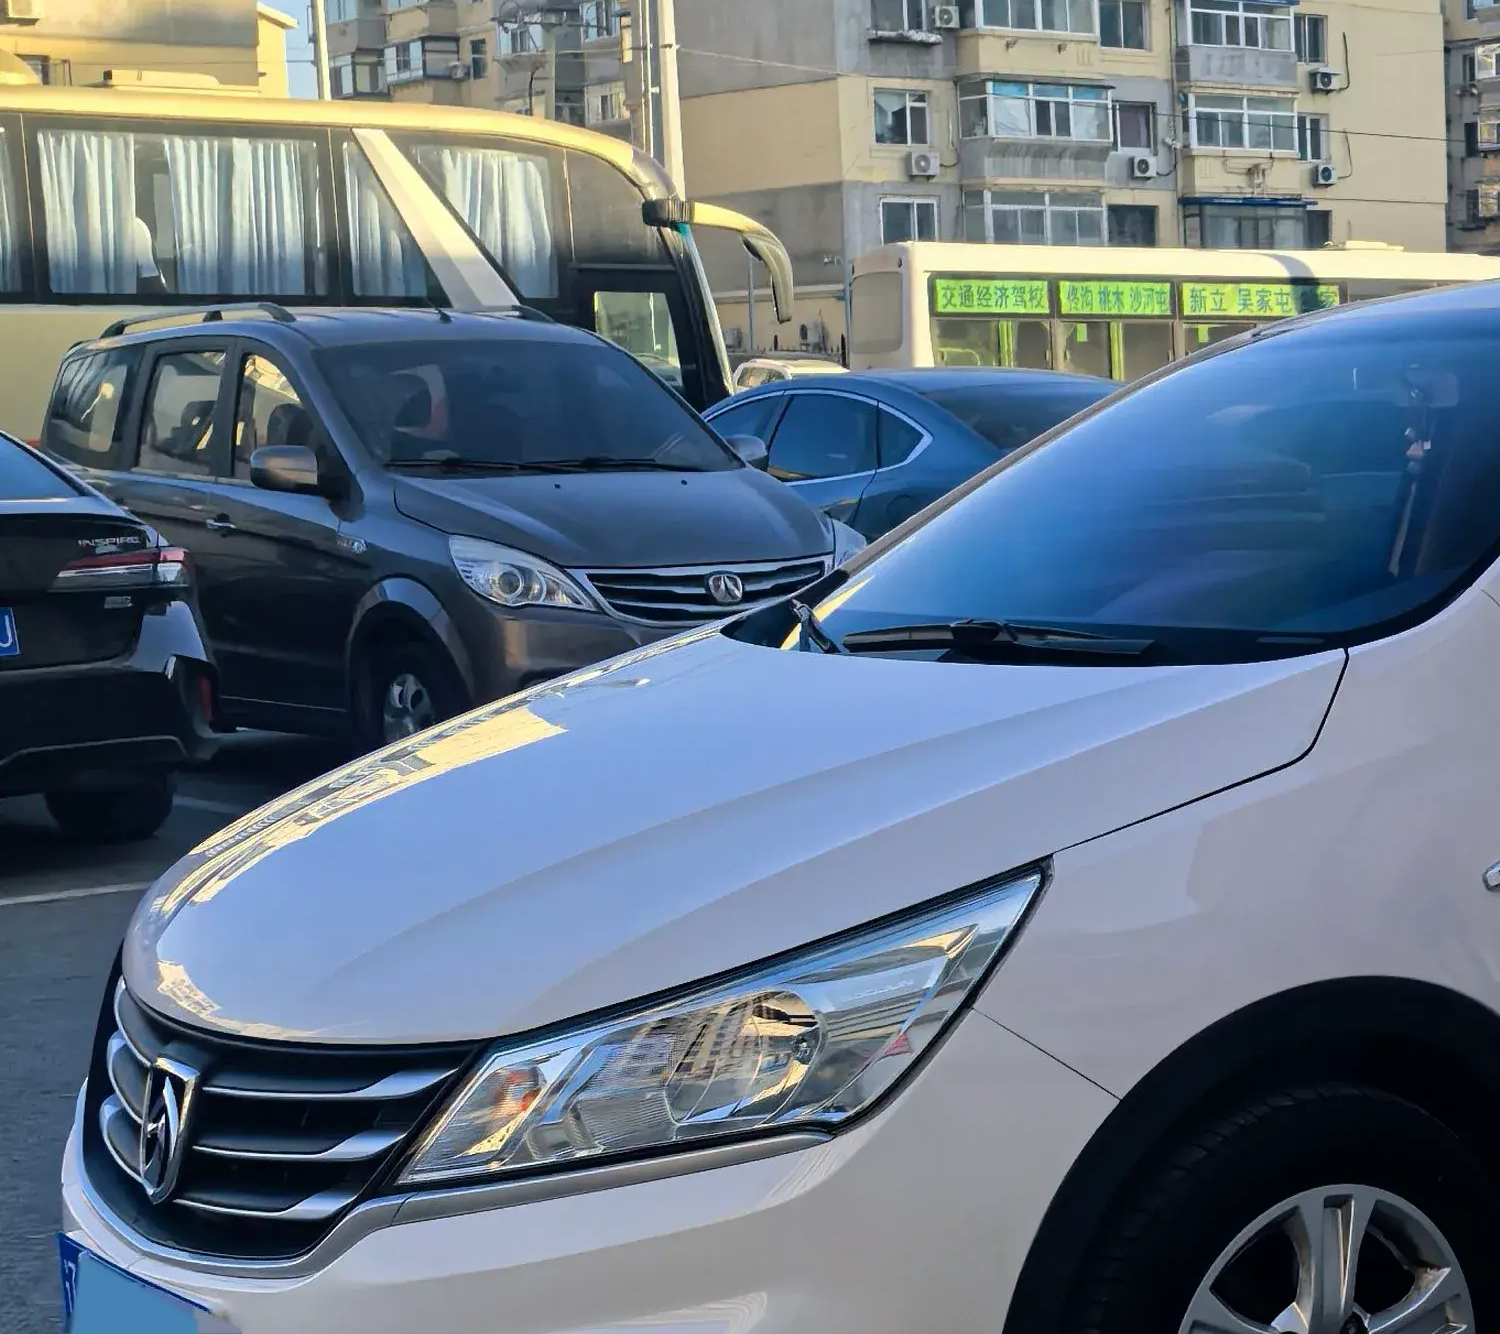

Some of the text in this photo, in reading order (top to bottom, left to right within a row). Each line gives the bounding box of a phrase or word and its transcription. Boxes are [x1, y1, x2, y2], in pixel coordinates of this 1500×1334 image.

[941, 284, 1045, 309] 交通经济驾校
[1189, 287, 1227, 313] 新立
[1237, 287, 1293, 314] 吴家屯
